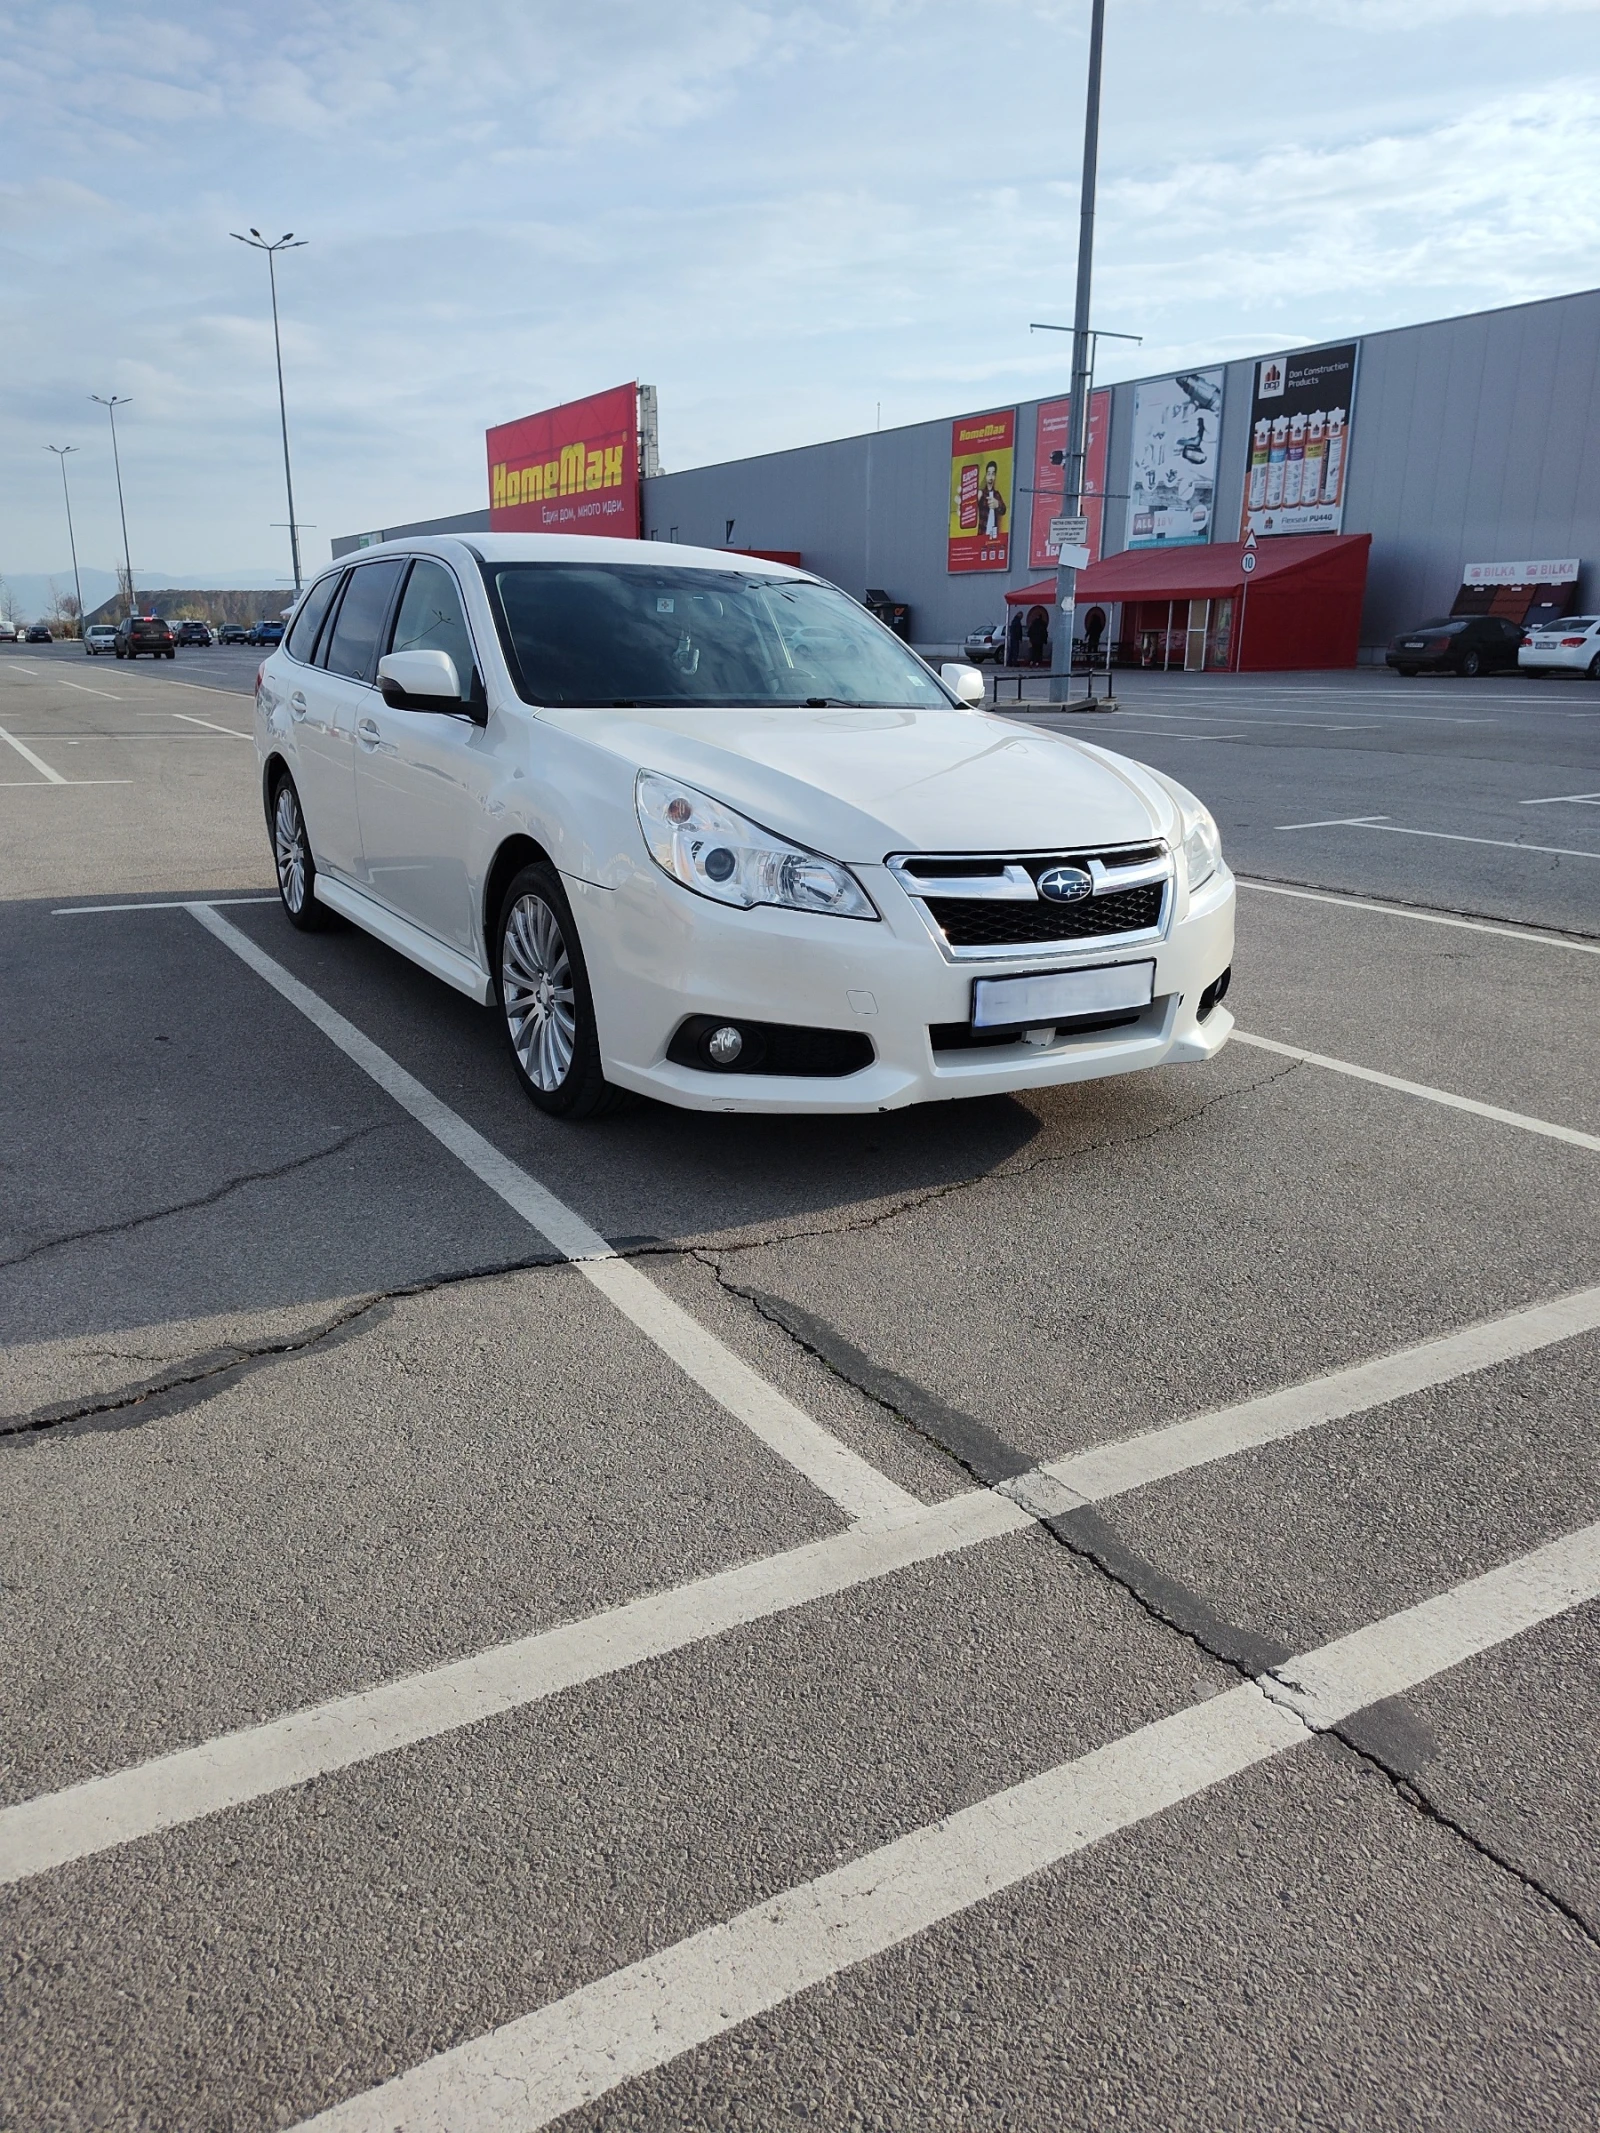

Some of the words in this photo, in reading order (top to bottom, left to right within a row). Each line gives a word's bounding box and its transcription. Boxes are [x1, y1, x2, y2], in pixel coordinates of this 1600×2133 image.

[1289, 370, 1302, 379] Don
[1304, 362, 1349, 376] Construction
[1288, 377, 1319, 388] Products
[959, 424, 1006, 441] HomeMax
[493, 442, 623, 509] HomeMax
[541, 505, 559, 525] Един
[559, 507, 576, 523] дом,
[577, 502, 601, 518] много
[602, 499, 625, 516] идеи.
[1135, 518, 1153, 530] ALL
[1244, 556, 1254, 569] 10
[1484, 566, 1516, 577] BILKA
[1540, 563, 1574, 576] BILKA
